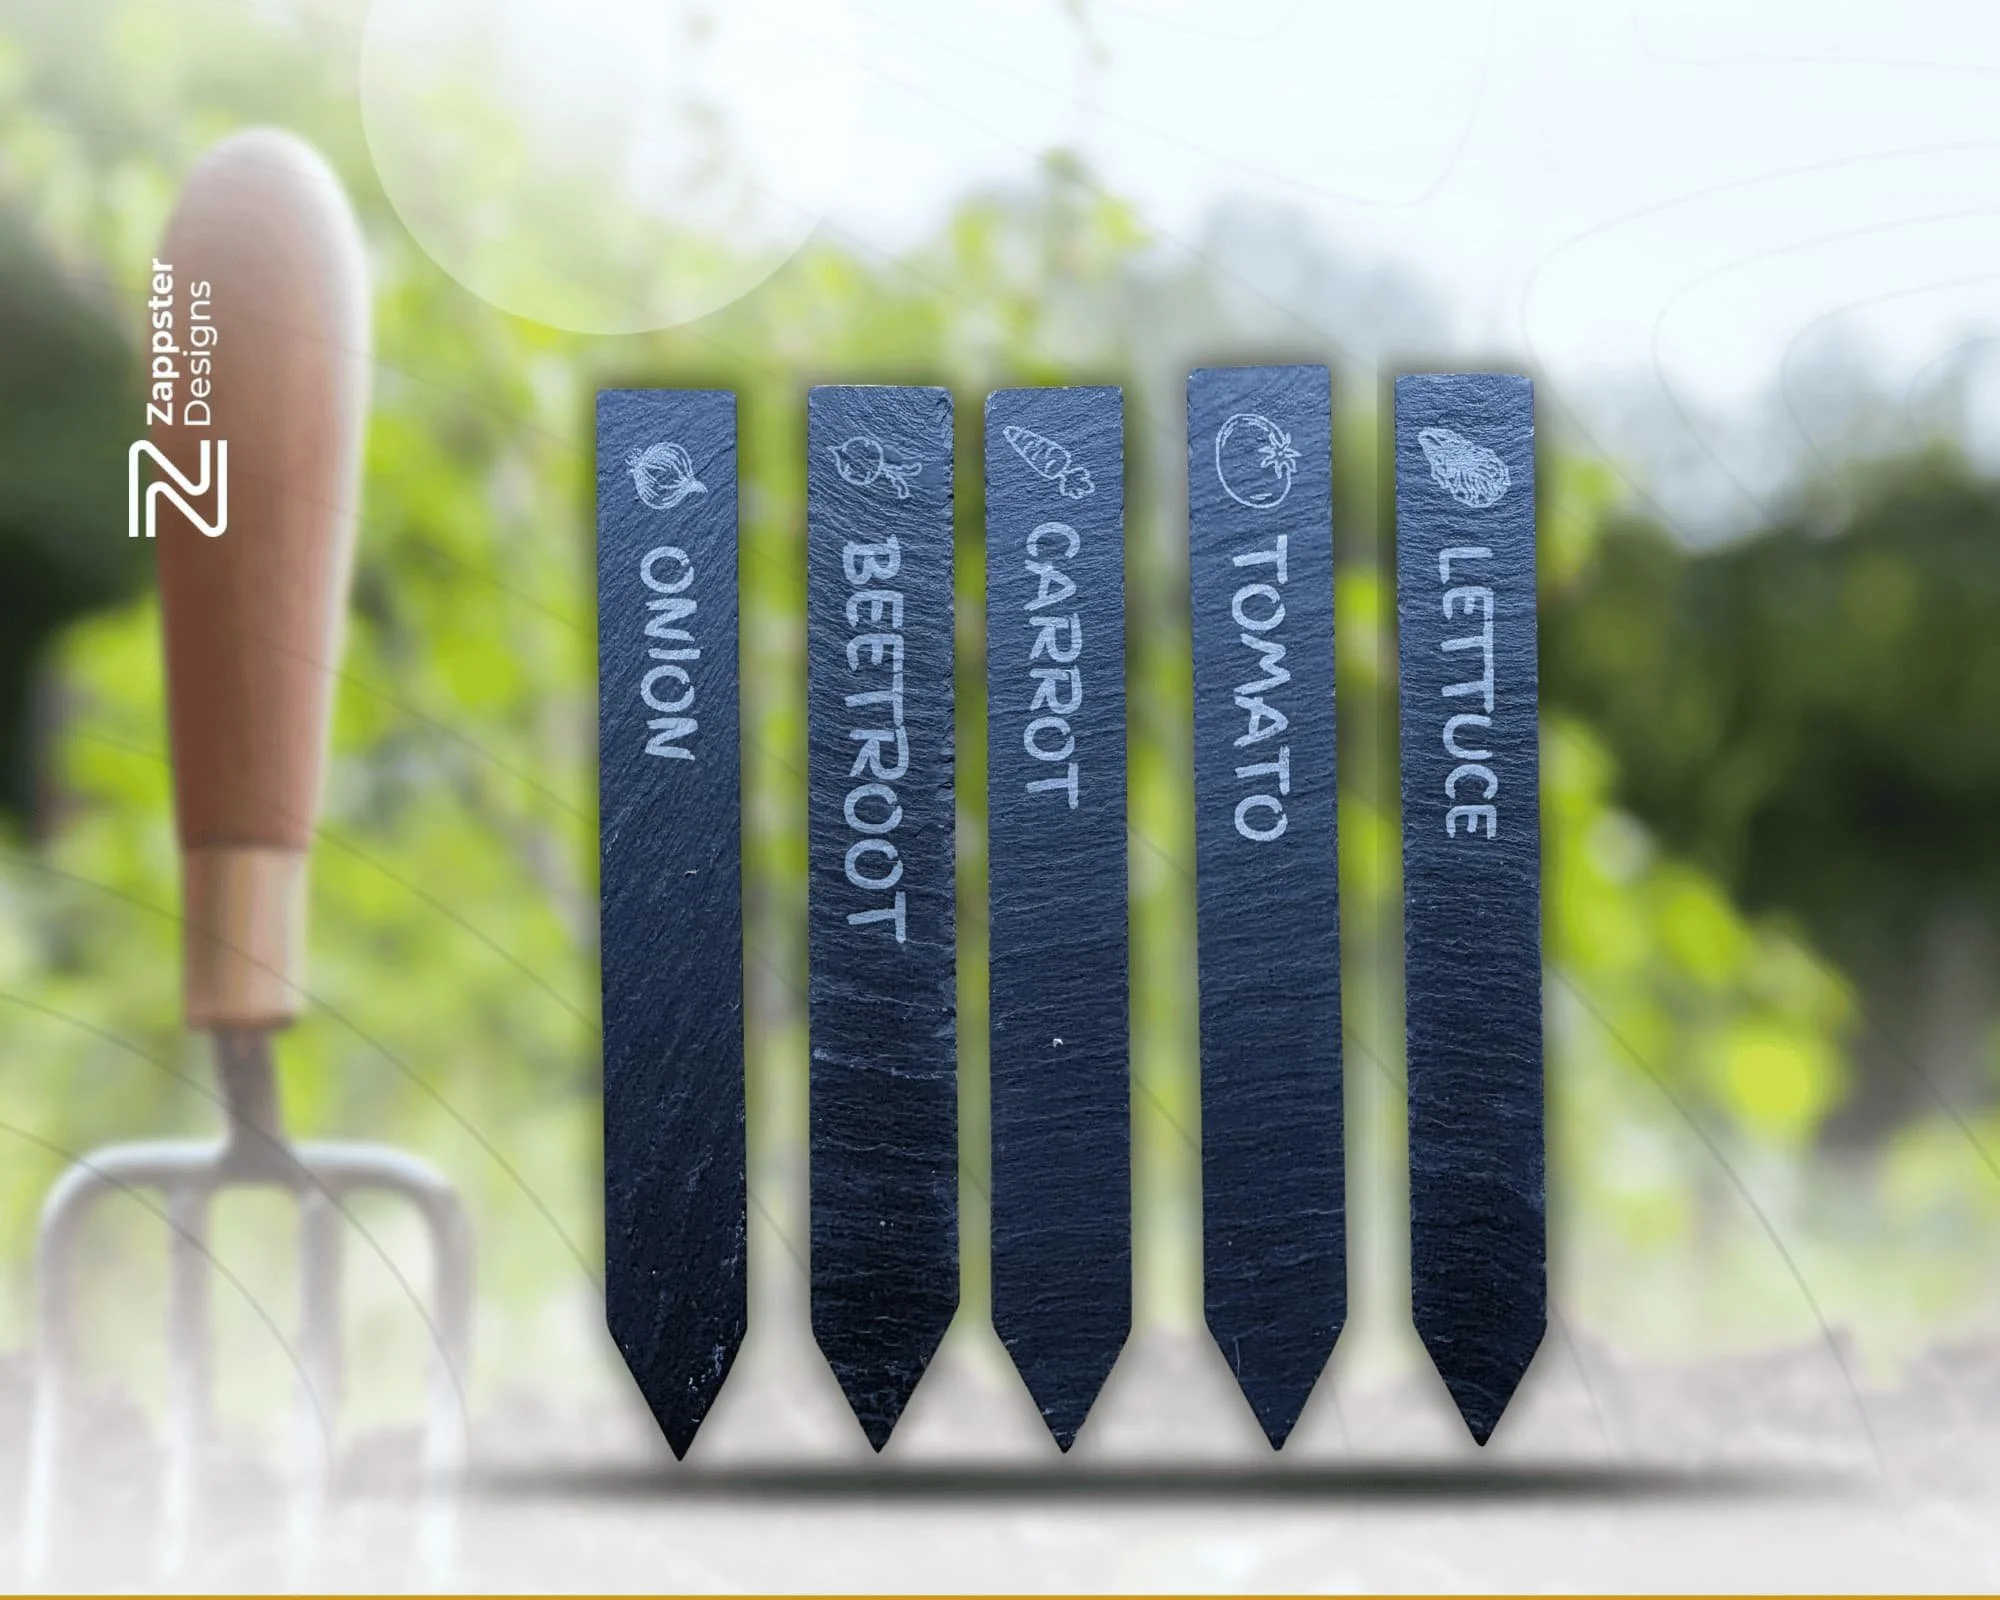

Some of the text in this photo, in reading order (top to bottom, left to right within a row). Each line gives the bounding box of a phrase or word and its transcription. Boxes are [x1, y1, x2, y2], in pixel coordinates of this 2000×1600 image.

[640, 545, 701, 760] ONION
[842, 534, 909, 944] BEETROOT
[1023, 521, 1083, 810] CARROT
[1231, 534, 1291, 841] TOMATO
[1438, 546, 1498, 839] LETTUCE
